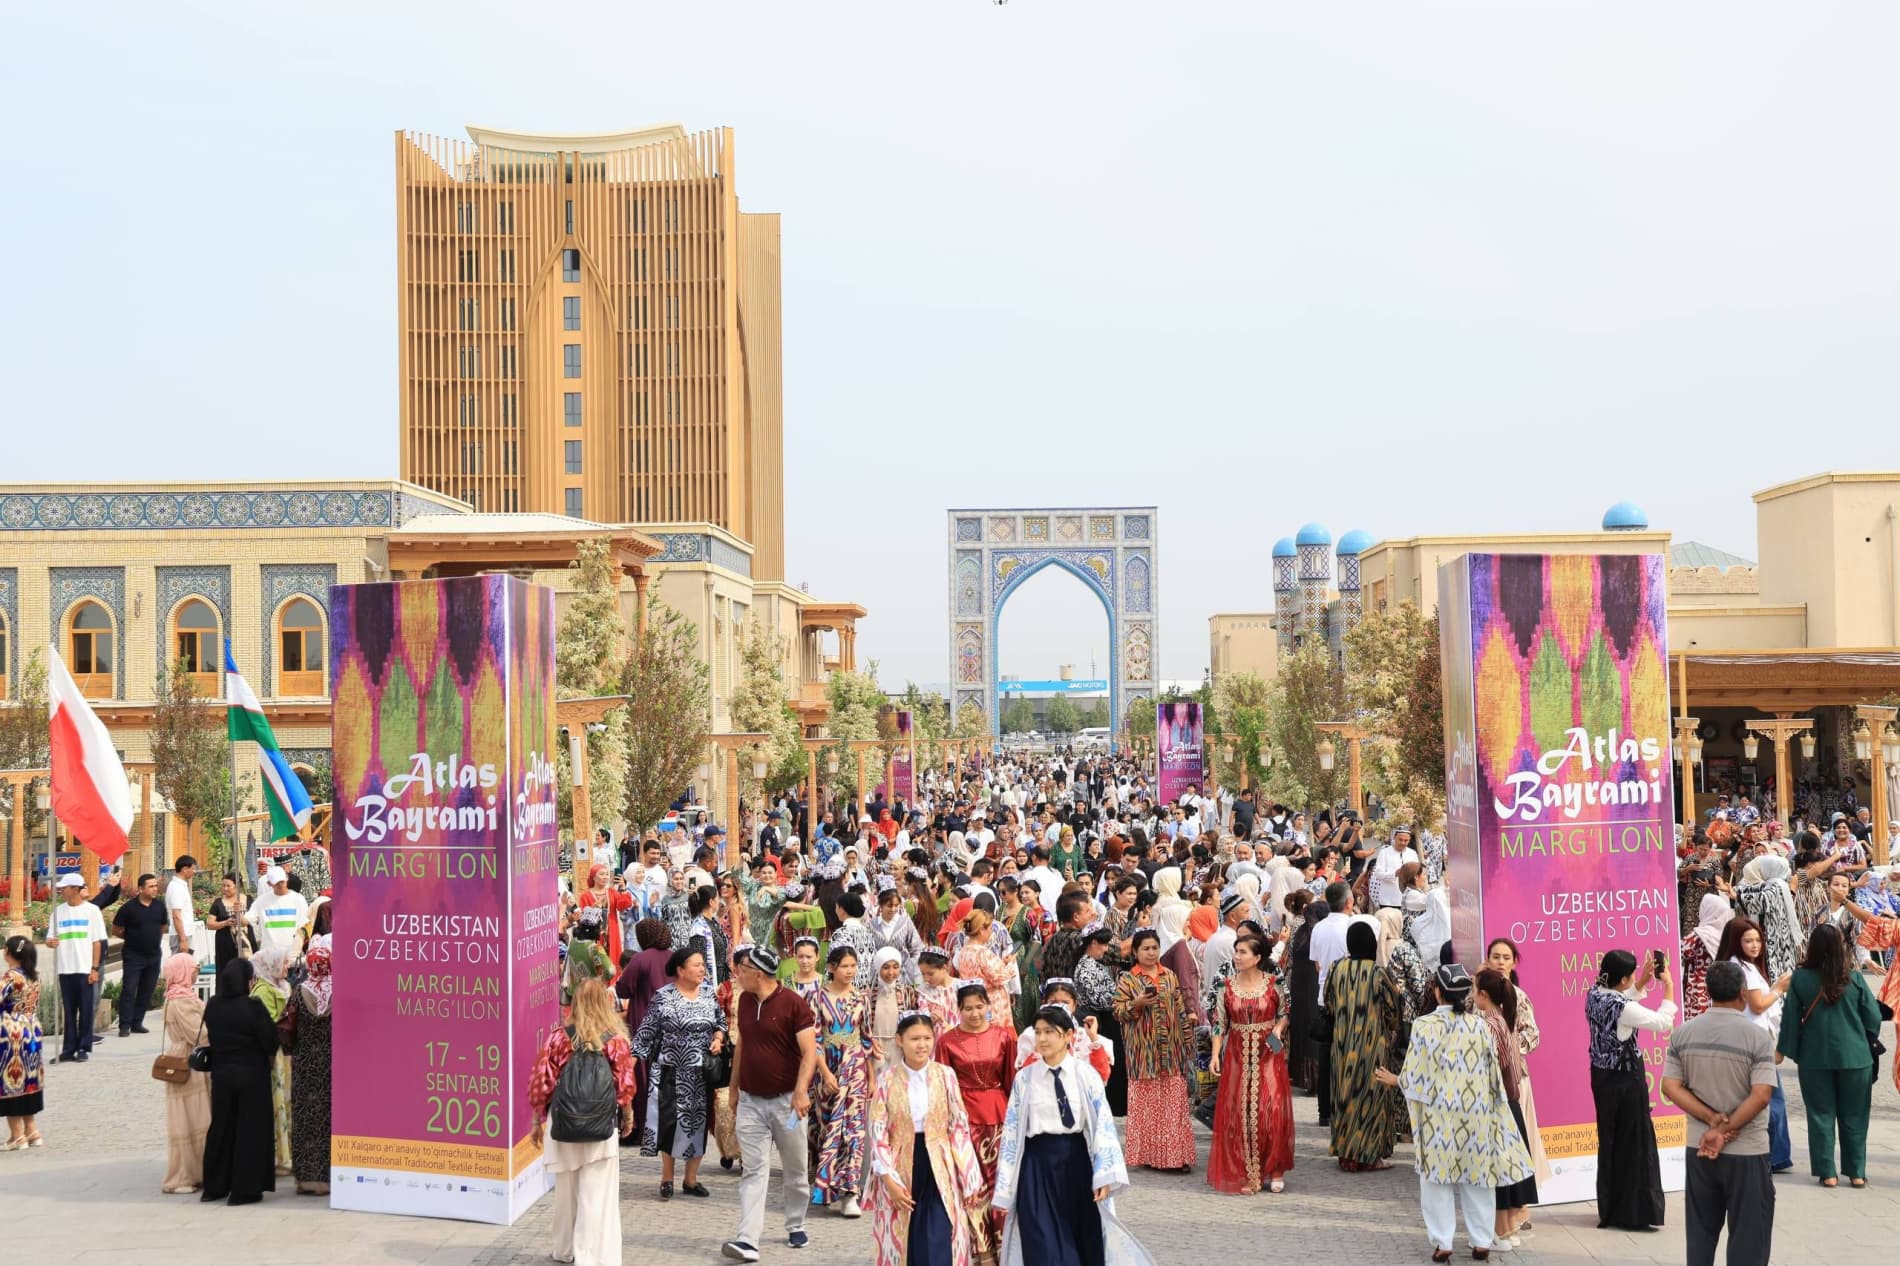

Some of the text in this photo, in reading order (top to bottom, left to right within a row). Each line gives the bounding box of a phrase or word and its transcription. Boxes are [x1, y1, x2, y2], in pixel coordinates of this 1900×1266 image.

[1162, 750, 1201, 762] Bayrami
[1536, 727, 1660, 776] Atlas
[382, 752, 497, 799] Atlas
[524, 750, 555, 797] Atlas
[1494, 768, 1661, 821] Bayrami
[345, 794, 497, 842] Bayrami
[514, 790, 556, 840] Bayrami
[1501, 826, 1663, 859] MARG'ILON
[350, 851, 497, 879] MARG'ILON
[1542, 888, 1667, 916] UZBEKISTAN
[383, 914, 499, 938] UZBEKISTAN
[524, 903, 557, 931] UZBEKISTAN
[1510, 914, 1669, 944] O'ZBEKISTON
[354, 938, 499, 964] O'ZBEKISTON
[397, 973, 499, 996] MARGILAN
[396, 997, 499, 1020] MARG'ILON
[425, 1041, 449, 1068] 17
[475, 1045, 500, 1070] 19
[426, 1073, 500, 1096] SENTABR
[426, 1096, 500, 1137] 2026
[1655, 1119, 1683, 1130] estivali
[1656, 1132, 1683, 1143] estival
[351, 1153, 402, 1166] International
[404, 1156, 445, 1169] Traditional
[448, 1160, 472, 1172] Textile
[474, 1163, 503, 1176] Festival
